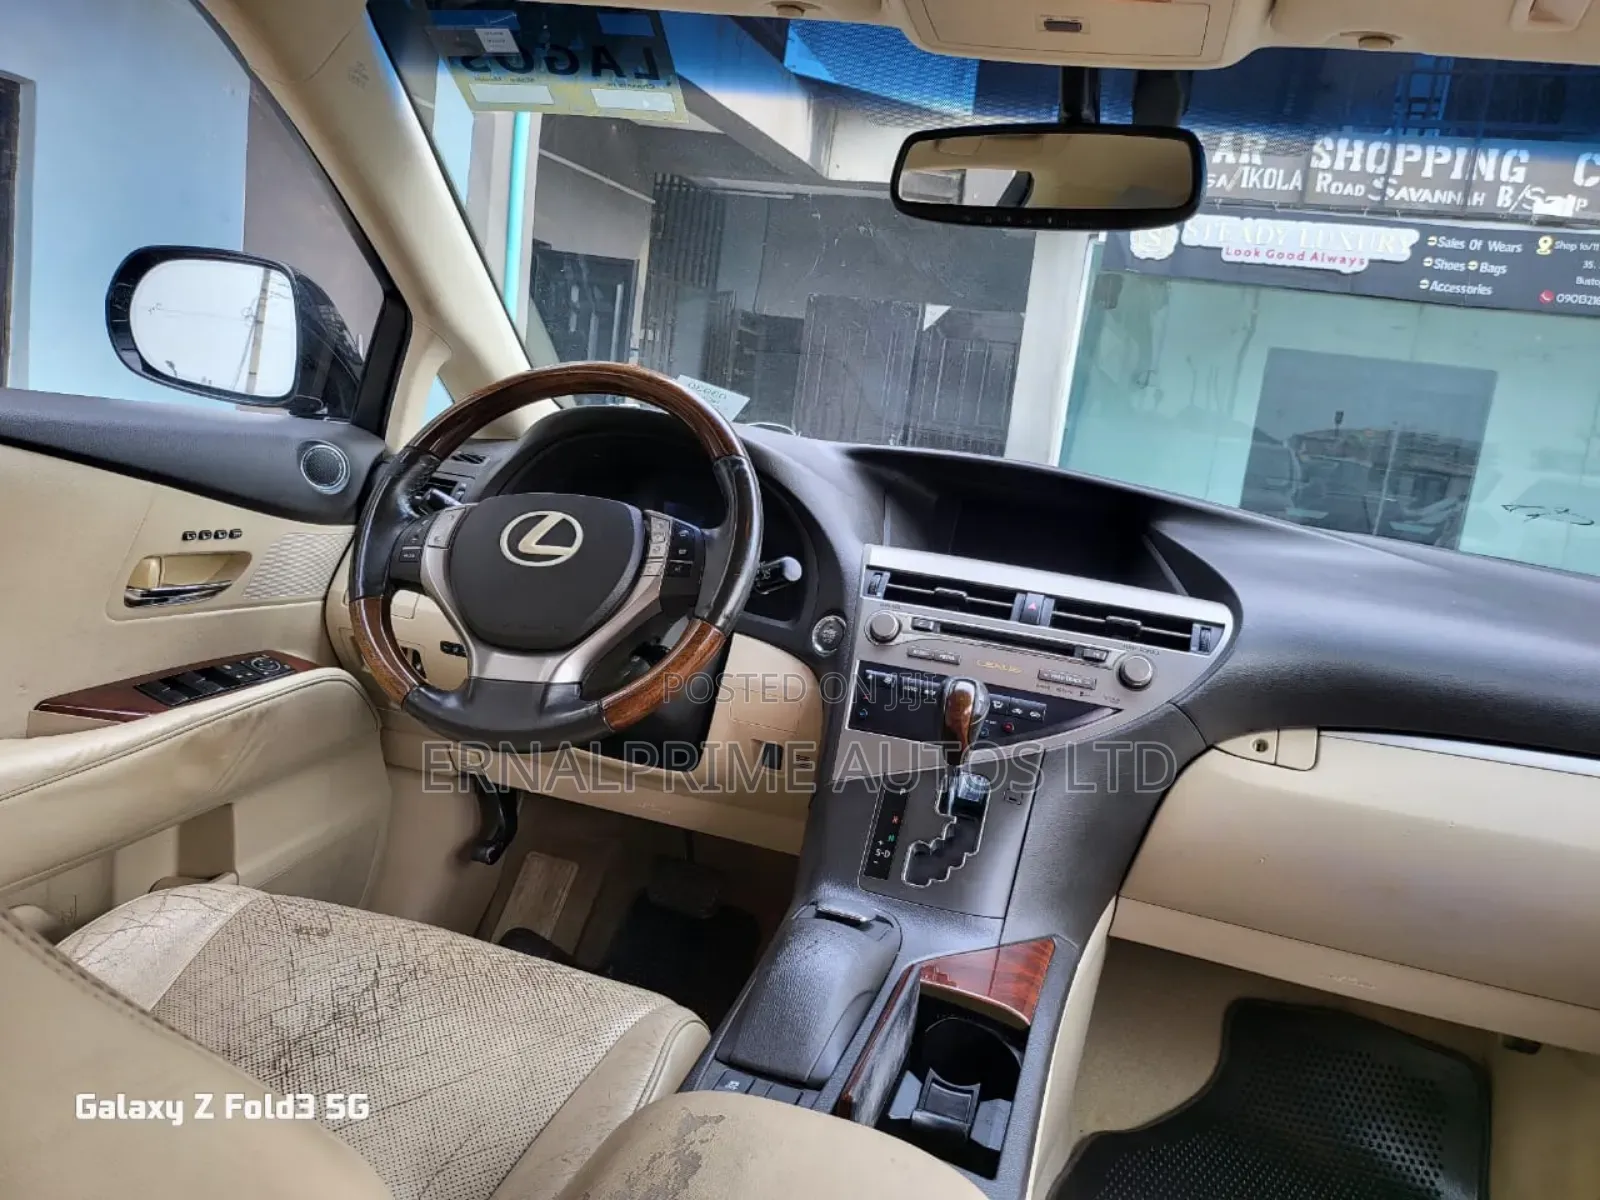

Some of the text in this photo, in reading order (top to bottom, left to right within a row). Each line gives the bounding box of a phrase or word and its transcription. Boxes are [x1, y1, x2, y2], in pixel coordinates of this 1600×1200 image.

[1310, 136, 1530, 184] SHOPPING
[1184, 221, 1418, 254] STEADY LUXURY
[1437, 236, 1466, 250] Sales
[1488, 240, 1523, 253] Wears
[1225, 247, 1366, 268] Look Good Always
[1433, 257, 1466, 272] Shoes
[1479, 261, 1508, 276] Bags
[1429, 279, 1493, 296] Accessories
